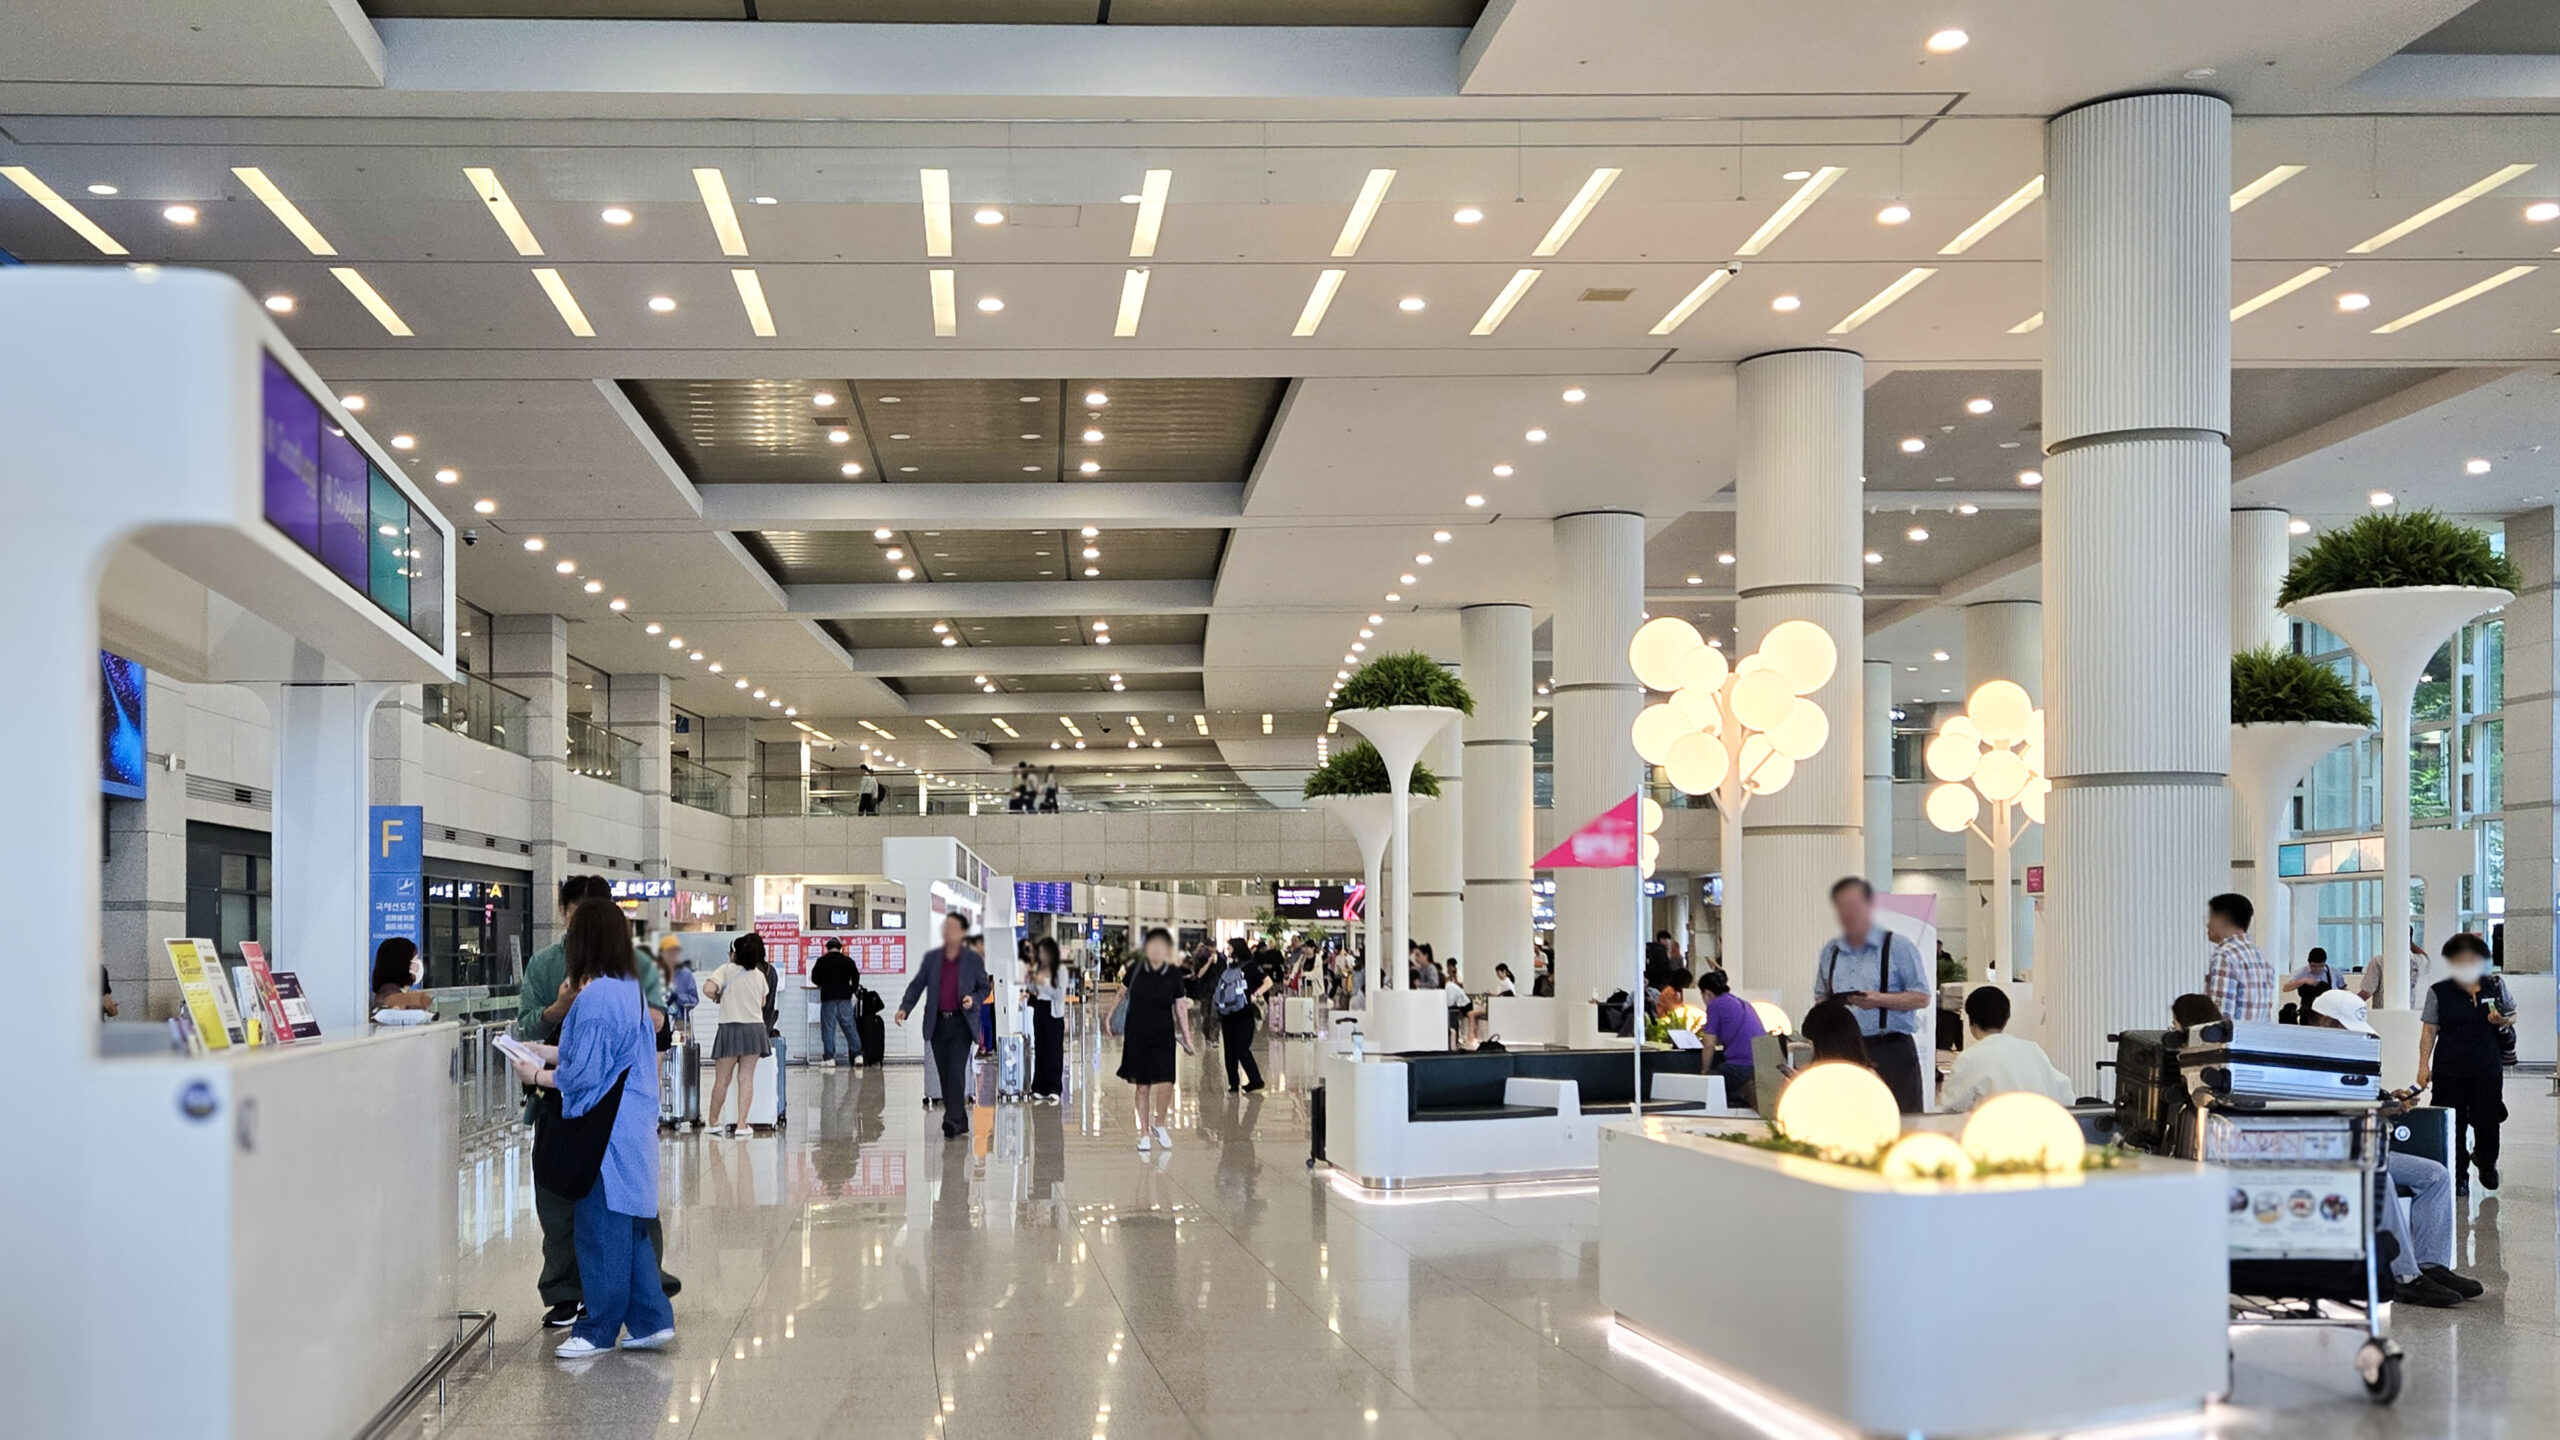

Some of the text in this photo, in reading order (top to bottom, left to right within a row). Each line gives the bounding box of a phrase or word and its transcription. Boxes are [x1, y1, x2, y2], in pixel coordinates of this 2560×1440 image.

[382, 820, 403, 858] F
[490, 882, 502, 898] A
[375, 902, 416, 912] 국제선도착
[1016, 912, 1025, 927] E
[1092, 917, 1099, 930] E
[755, 923, 768, 931] Buy
[810, 937, 822, 945] SK
[851, 937, 872, 945] eSIM
